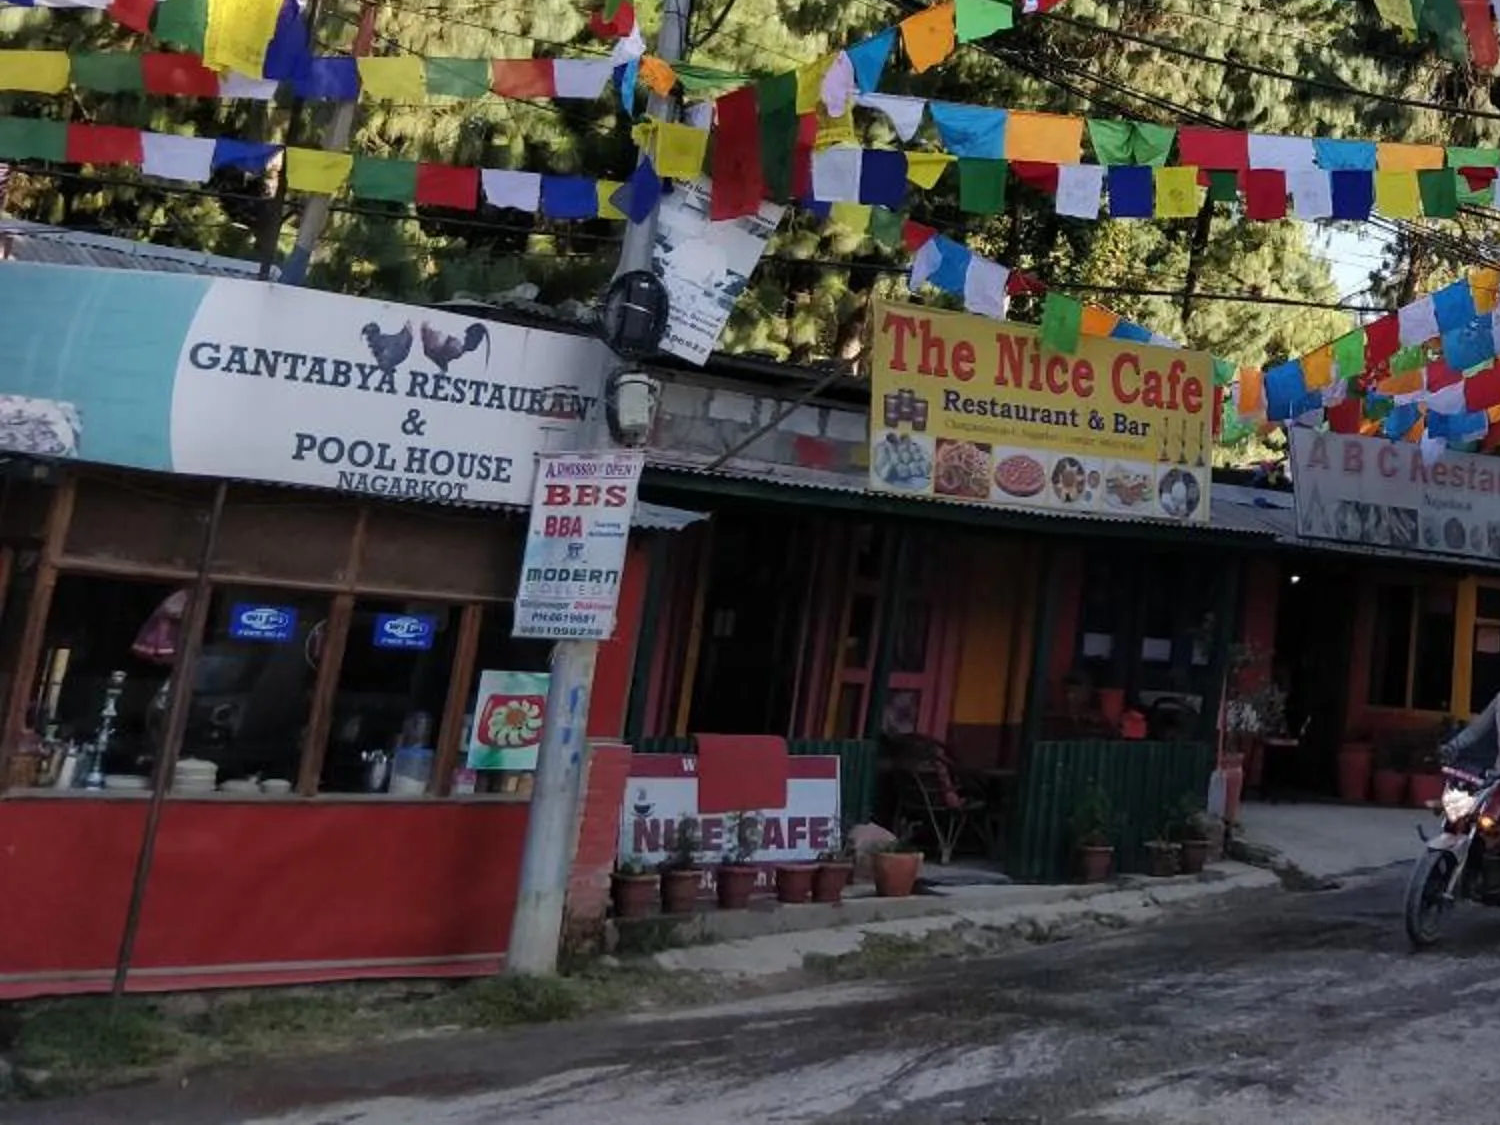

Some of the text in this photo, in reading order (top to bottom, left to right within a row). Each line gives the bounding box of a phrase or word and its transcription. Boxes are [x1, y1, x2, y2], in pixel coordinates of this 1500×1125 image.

[188, 341, 398, 395] GANTABYA
[882, 311, 1204, 415] The Nice Cafe
[400, 408, 426, 437] &
[942, 388, 1080, 428] Restaurant
[1086, 409, 1106, 431] &
[1112, 412, 1151, 438] Bar
[290, 432, 514, 484] POOL HOUSE
[1306, 436, 1330, 470] A
[1342, 440, 1364, 473] B
[1376, 446, 1399, 478] C
[338, 470, 469, 502] NAGARKOT
[542, 484, 627, 508] BBS
[543, 515, 583, 538] BBA
